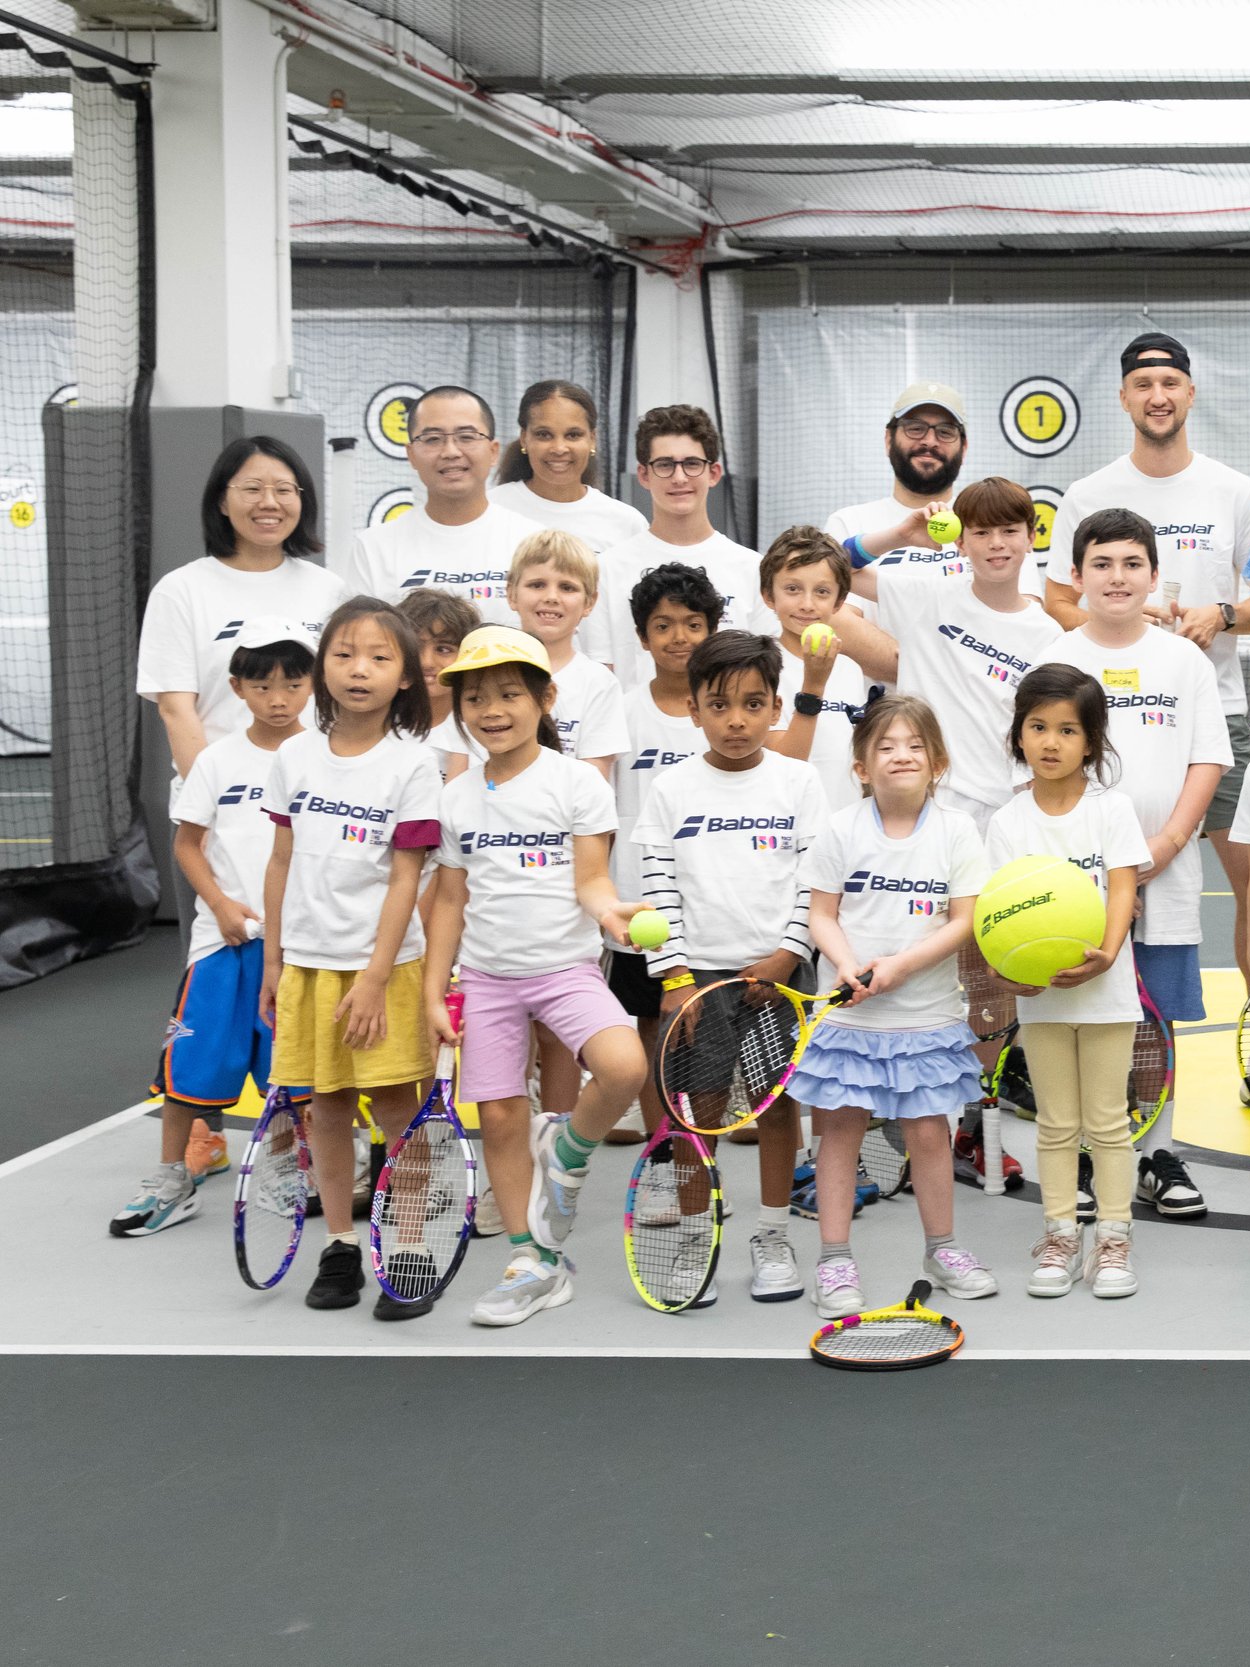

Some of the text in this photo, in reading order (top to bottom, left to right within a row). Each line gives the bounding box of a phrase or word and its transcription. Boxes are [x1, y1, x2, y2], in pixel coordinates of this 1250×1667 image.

[1034, 406, 1043, 427] 1
[0, 483, 32, 501] ourt
[1176, 539, 1196, 550] 150
[909, 549, 959, 562] Babol
[943, 563, 963, 576] 150
[470, 586, 492, 600] 150
[987, 664, 1009, 682] 150
[1141, 712, 1164, 727] 150
[342, 824, 366, 843] 150
[752, 836, 778, 850] 150
[519, 852, 547, 867] 150
[908, 900, 934, 916] 150
